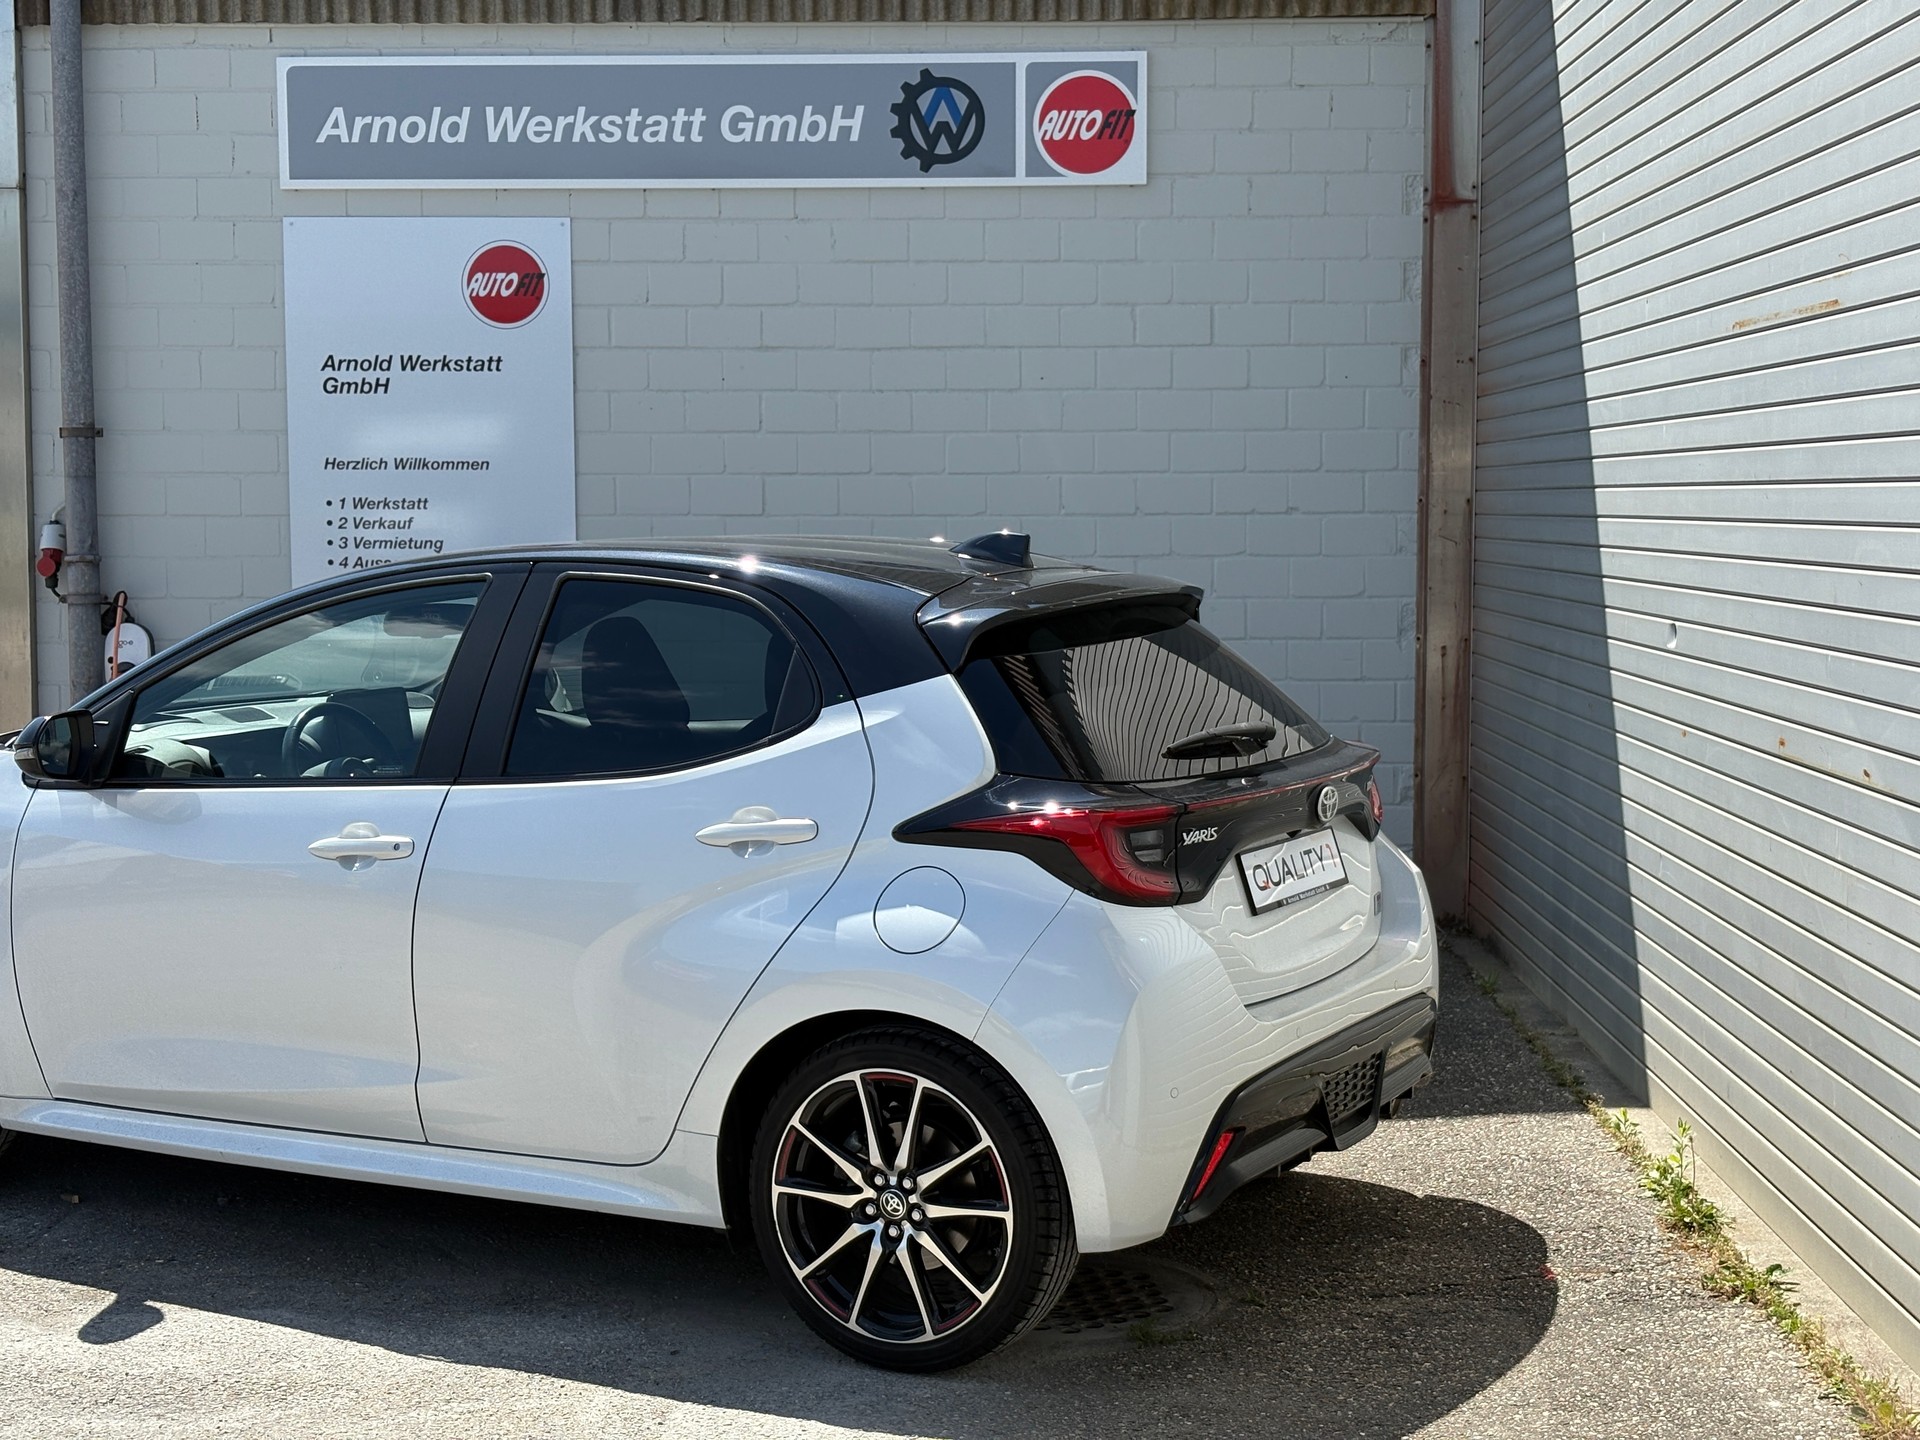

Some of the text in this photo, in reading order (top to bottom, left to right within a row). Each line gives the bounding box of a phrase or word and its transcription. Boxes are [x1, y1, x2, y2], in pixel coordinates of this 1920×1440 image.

[315, 104, 865, 144] Arnold Werkstatt GmbH
[1039, 108, 1137, 141] AUTOFIT
[468, 271, 546, 298] AUTOFIT
[320, 354, 504, 373] Arnold Werkstatt
[322, 376, 391, 395] GmbH
[323, 457, 491, 472] Herzlich Willkommen
[339, 497, 429, 510] 1 Werkstatt
[337, 516, 415, 530] 2 Verkauf
[338, 536, 444, 554] 3 Vermietung
[338, 556, 349, 569] 4
[1182, 826, 1219, 846] YARIS
